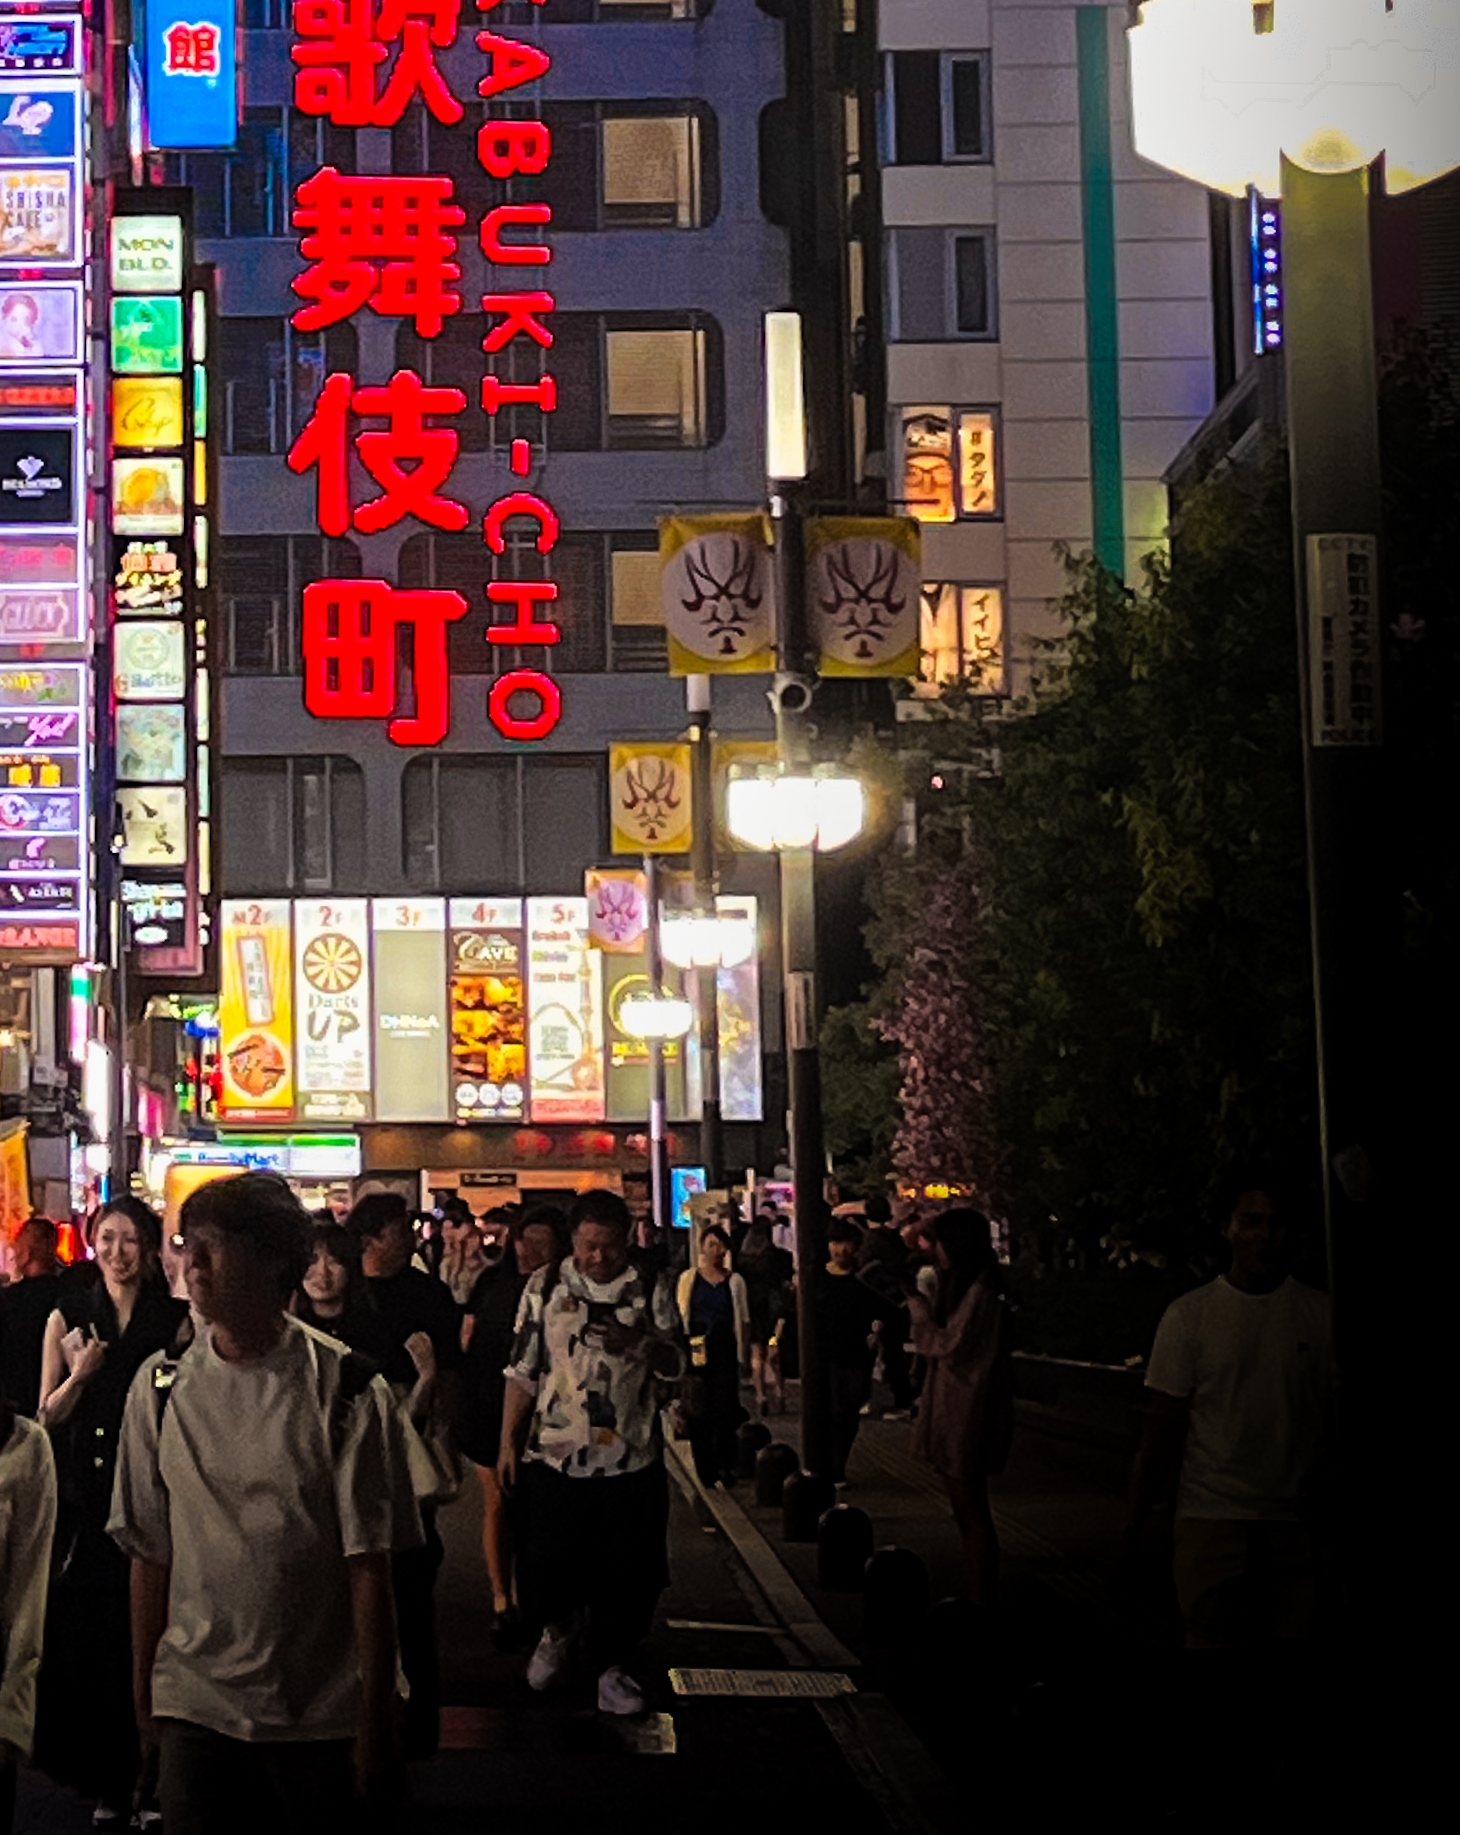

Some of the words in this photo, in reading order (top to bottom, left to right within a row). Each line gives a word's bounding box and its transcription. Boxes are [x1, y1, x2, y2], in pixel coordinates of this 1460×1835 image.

[6, 189, 67, 209] SHISHA
[118, 237, 175, 252] MON
[308, 993, 359, 1009] Darts
[307, 1008, 360, 1044] UP
